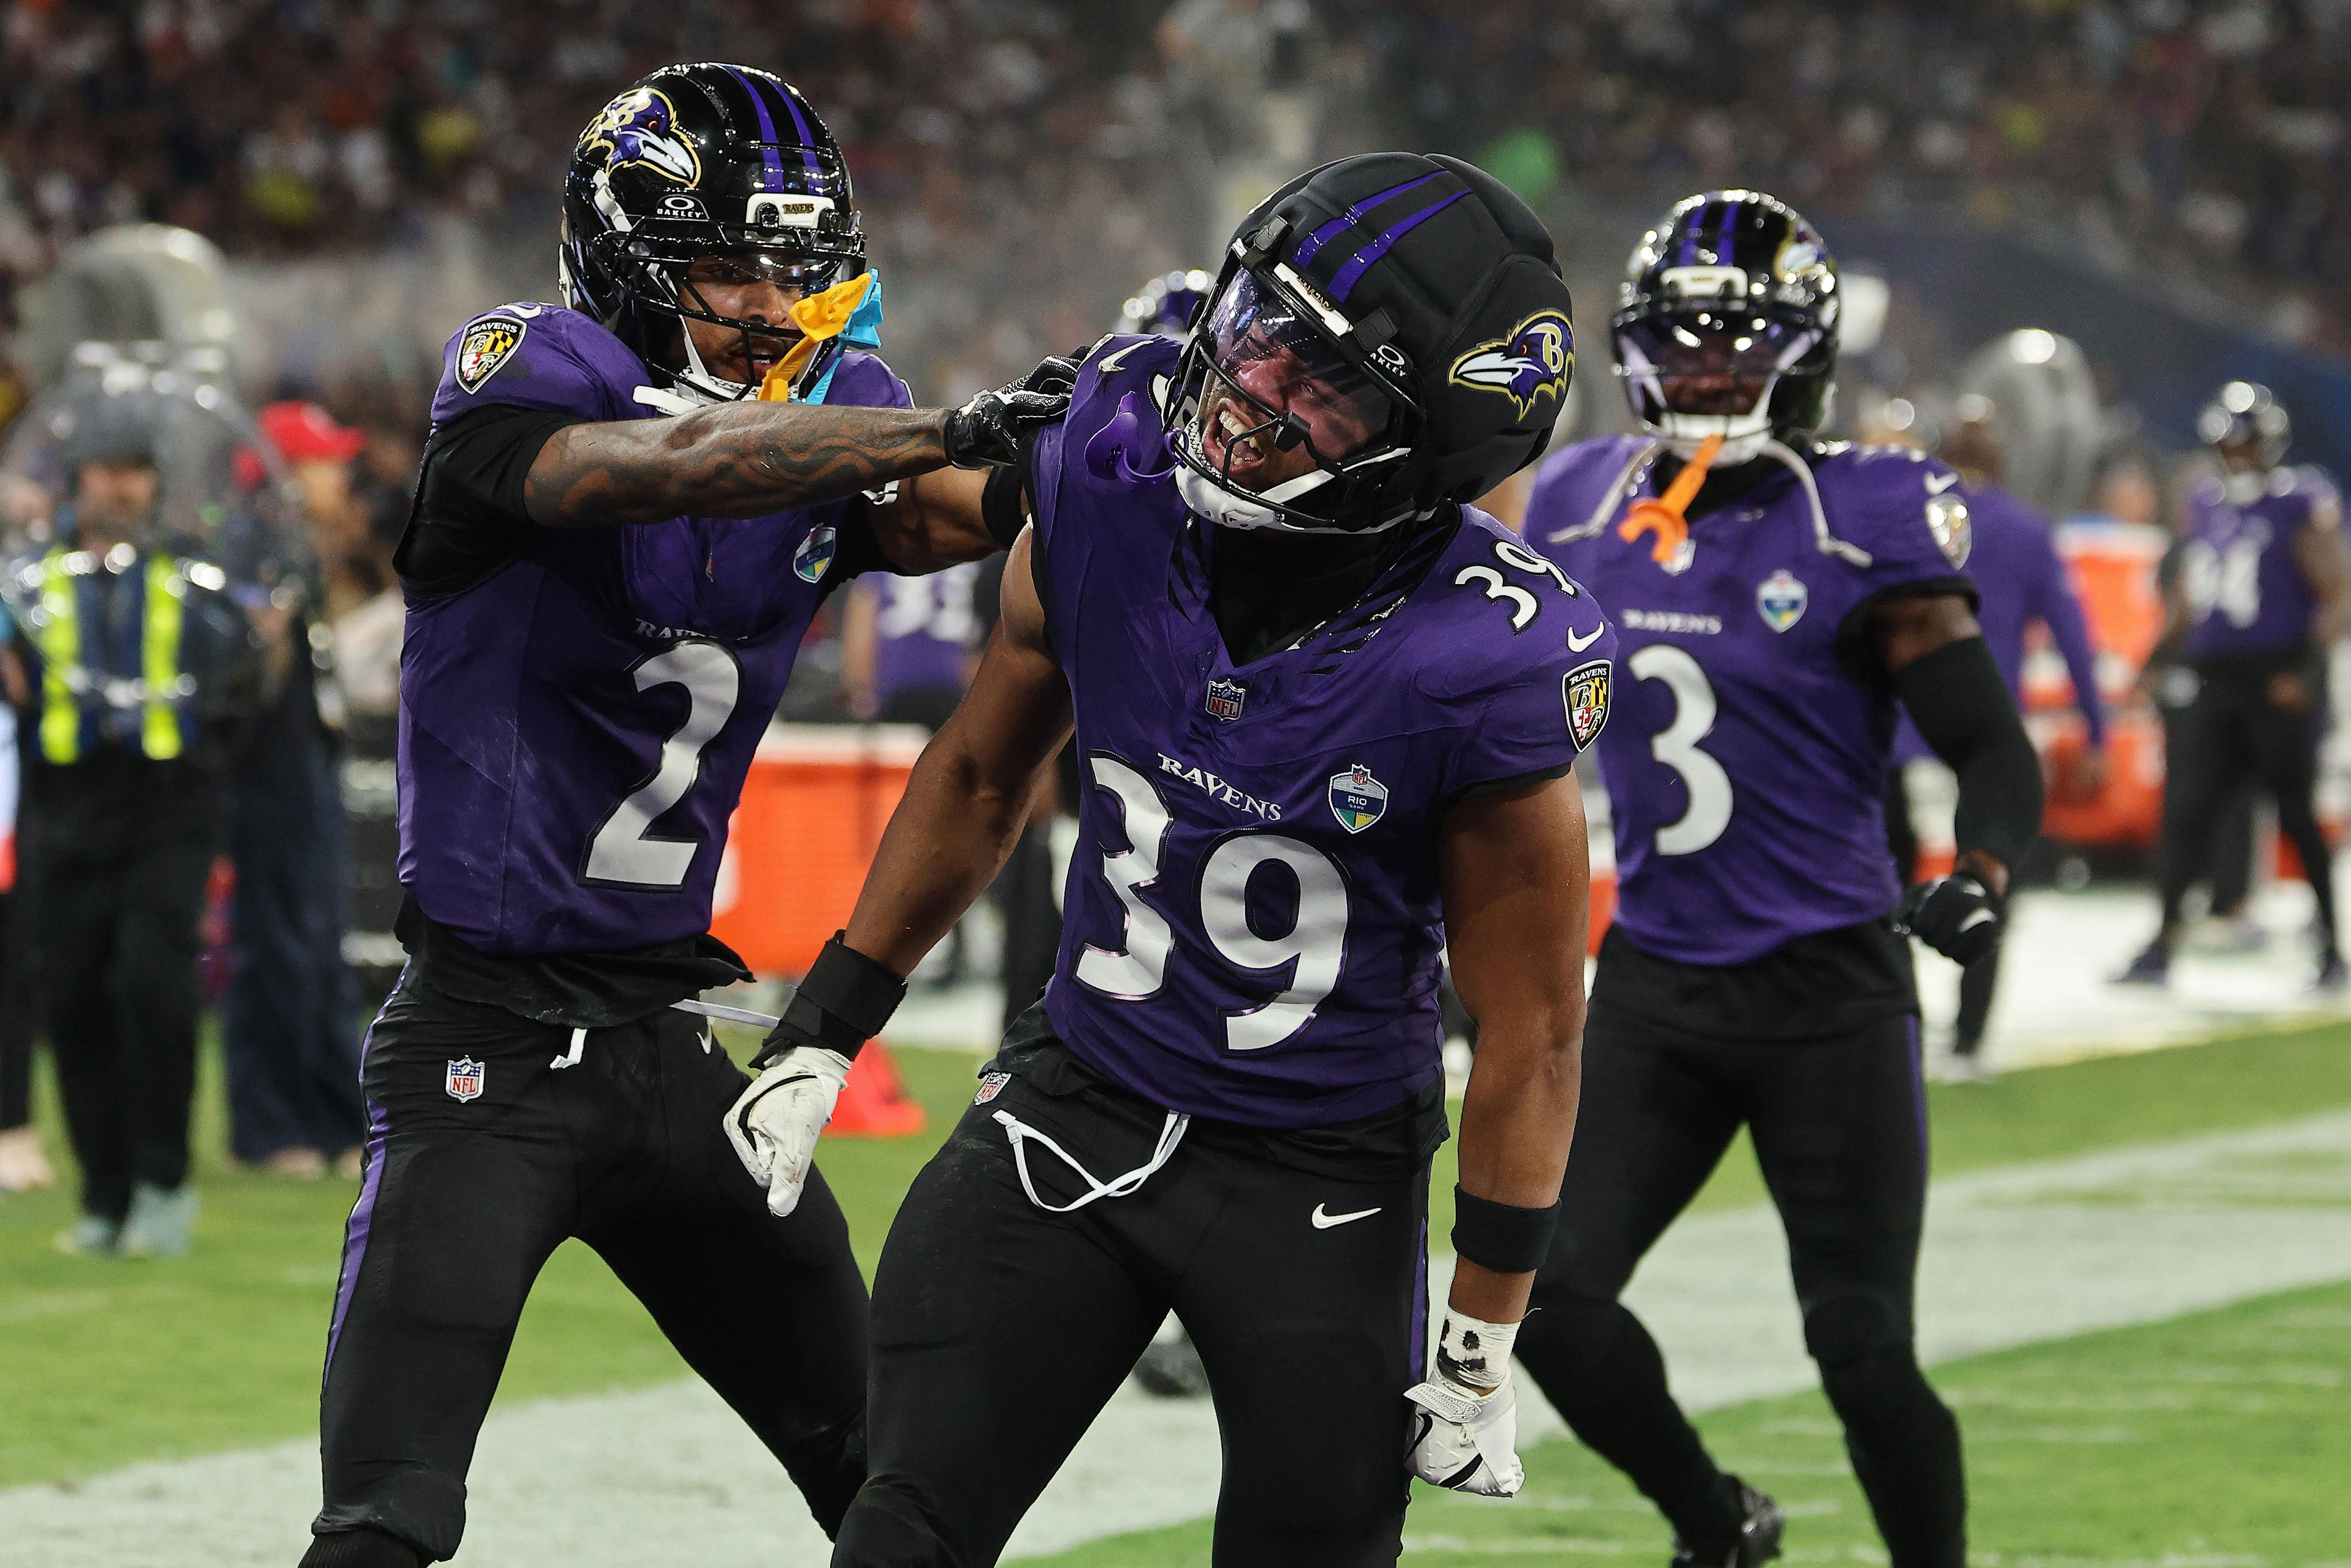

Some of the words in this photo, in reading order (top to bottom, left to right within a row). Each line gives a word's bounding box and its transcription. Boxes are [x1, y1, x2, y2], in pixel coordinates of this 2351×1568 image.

[656, 208, 704, 218] OAKLEY
[469, 322, 518, 335] RAVENS
[1369, 352, 1407, 377] AKLEY
[1454, 540, 1578, 632] 39
[1569, 667, 1607, 686] RAVENS
[1211, 698, 1237, 716] NFL
[1628, 644, 1734, 856] 3
[584, 642, 741, 886] 2
[1157, 752, 1281, 821] RAVENS
[1354, 774, 1368, 784] NFL
[1347, 795, 1368, 806] RIO
[1073, 755, 1349, 1052] 39
[452, 1077, 476, 1095] NFL
